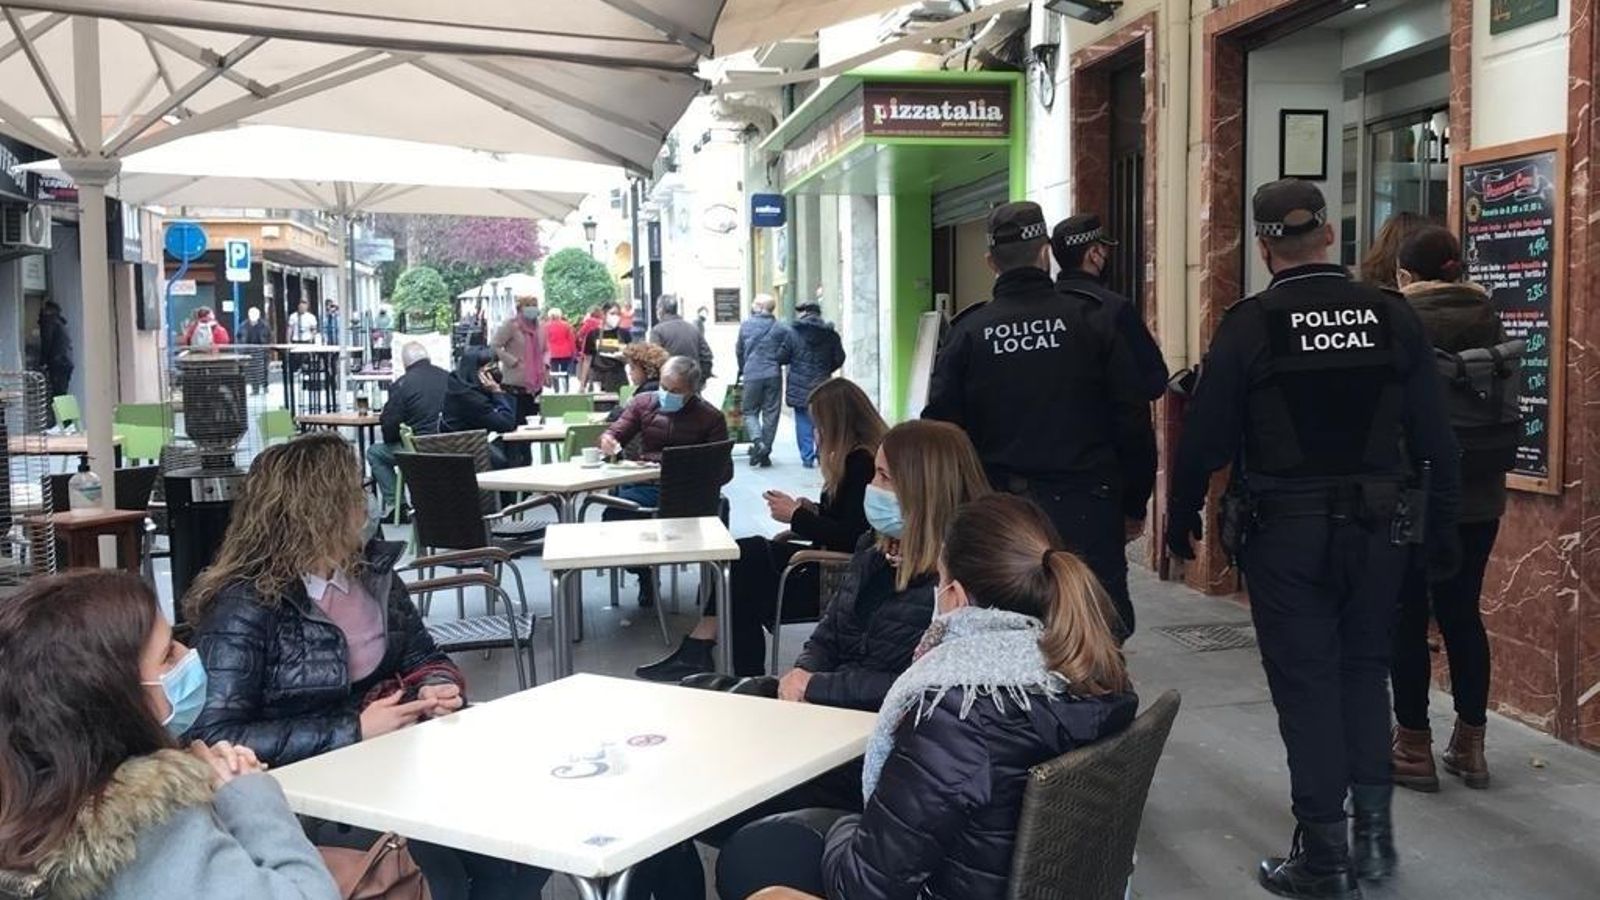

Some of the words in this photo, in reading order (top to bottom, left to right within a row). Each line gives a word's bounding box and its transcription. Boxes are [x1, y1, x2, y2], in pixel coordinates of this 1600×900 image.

[872, 97, 1003, 125] pizzatalia
[231, 243, 246, 269] P
[1291, 308, 1379, 328] POLICIA
[984, 318, 1066, 340] POLICIA
[993, 334, 1060, 354] LOCAL
[1301, 331, 1375, 351] LOCAL
